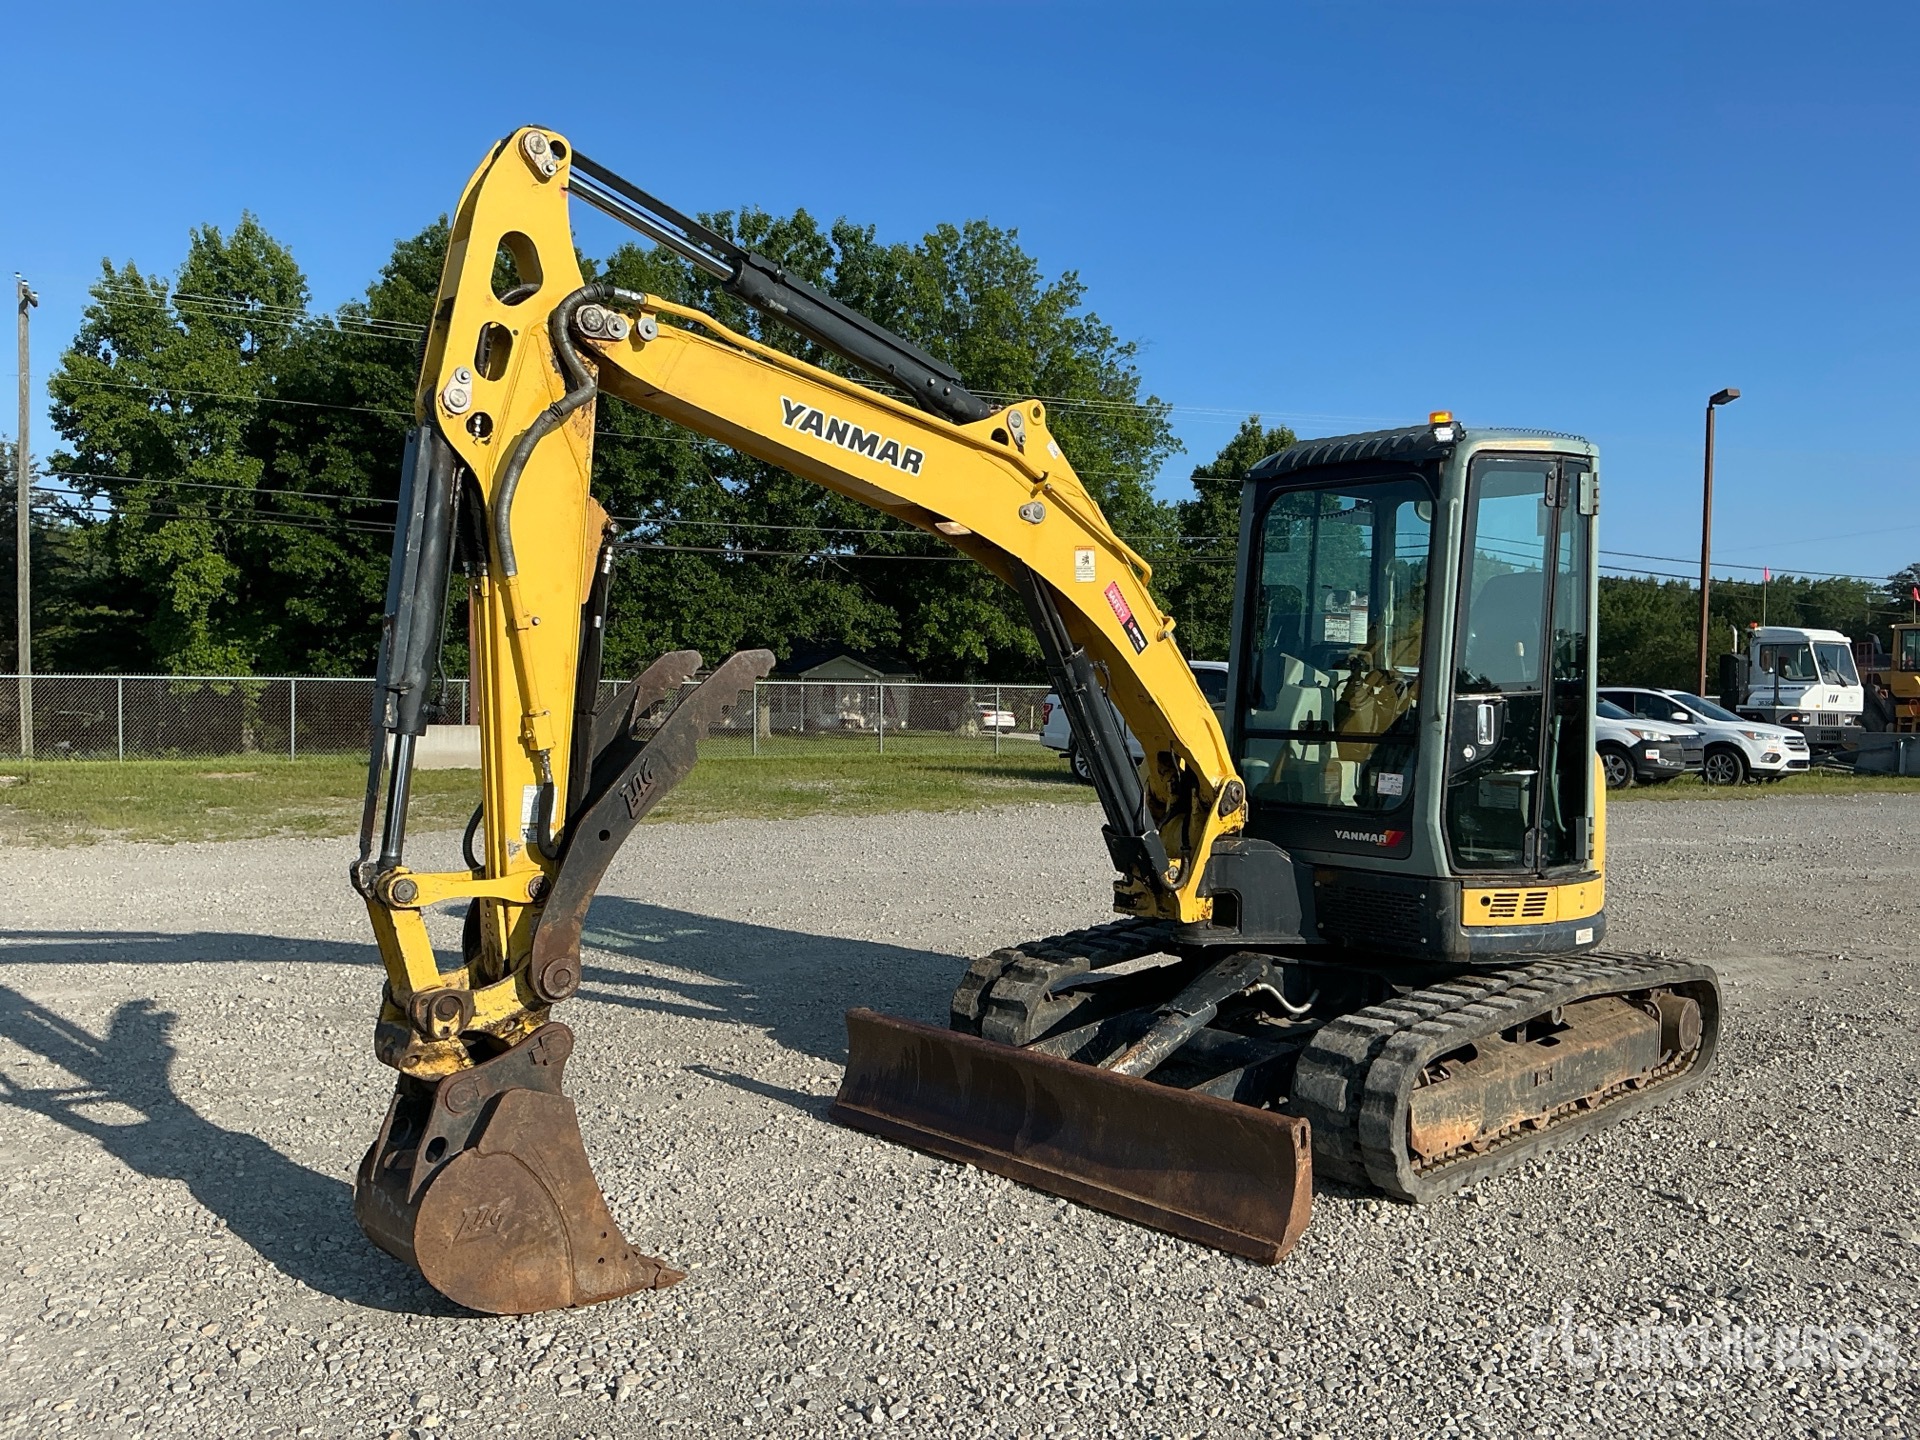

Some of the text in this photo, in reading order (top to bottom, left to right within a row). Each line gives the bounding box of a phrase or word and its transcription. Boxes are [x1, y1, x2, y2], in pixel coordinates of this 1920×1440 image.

[780, 396, 925, 477] YANMAR
[1107, 588, 1127, 618] SAFETY
[1334, 829, 1388, 843] YANMAR
